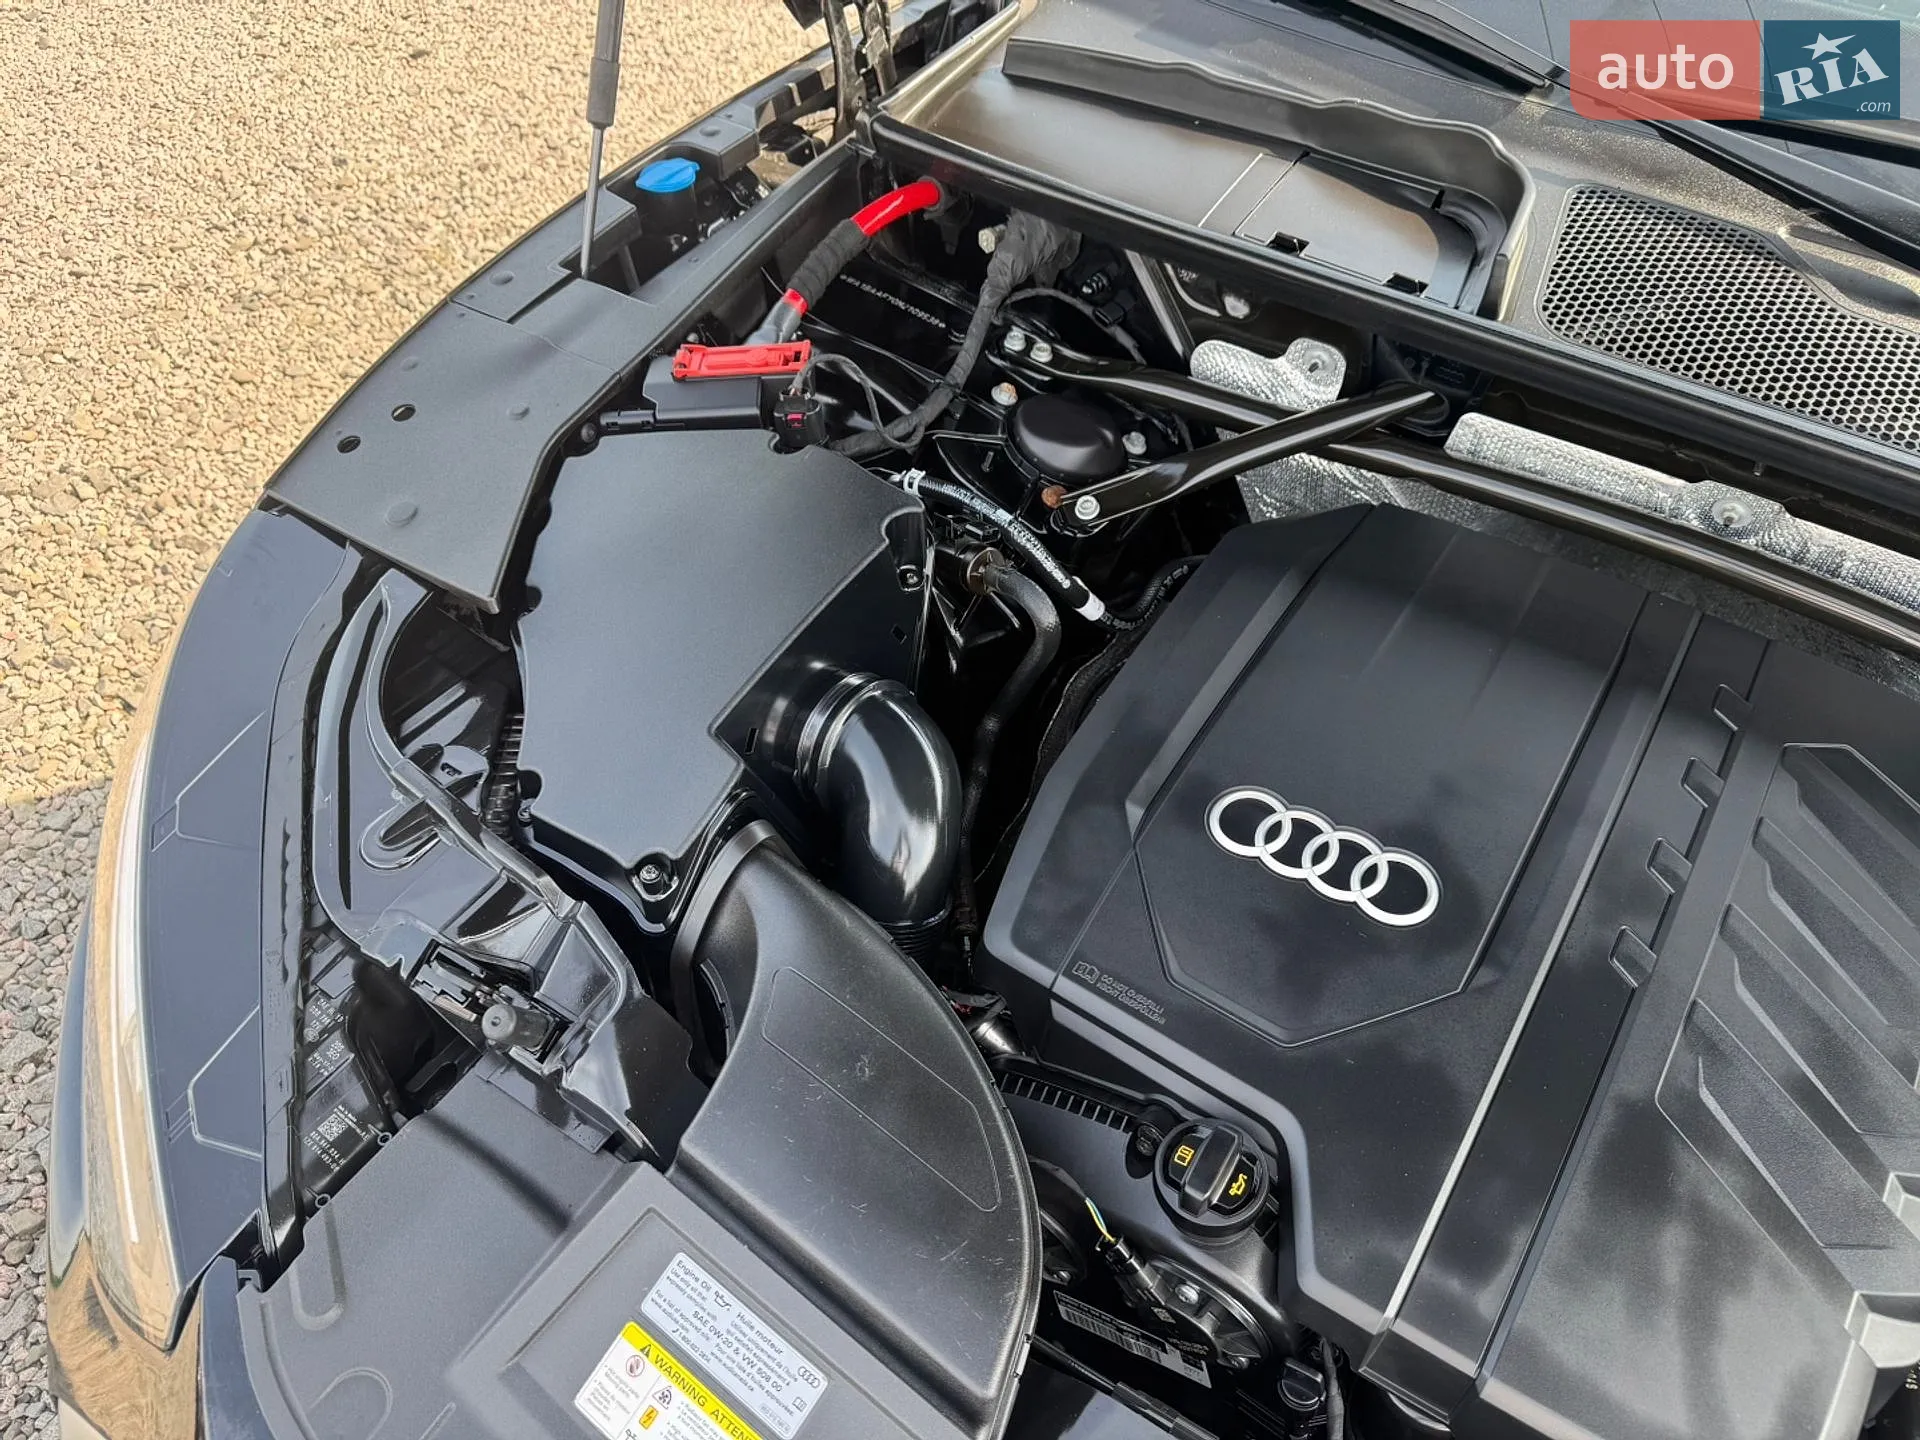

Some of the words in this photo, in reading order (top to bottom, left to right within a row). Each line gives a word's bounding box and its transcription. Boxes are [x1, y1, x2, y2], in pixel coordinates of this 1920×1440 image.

[675, 1259, 701, 1283] Engine
[699, 1279, 712, 1292] Oil
[691, 1309, 710, 1328] SAE
[707, 1323, 734, 1349] 0W-20
[732, 1345, 741, 1355] &
[740, 1352, 757, 1370] VW
[755, 1365, 772, 1383] 508
[770, 1379, 783, 1393] 00
[735, 1311, 756, 1331] Huile
[754, 1327, 784, 1356] moteur
[653, 1353, 706, 1408] WARNING
